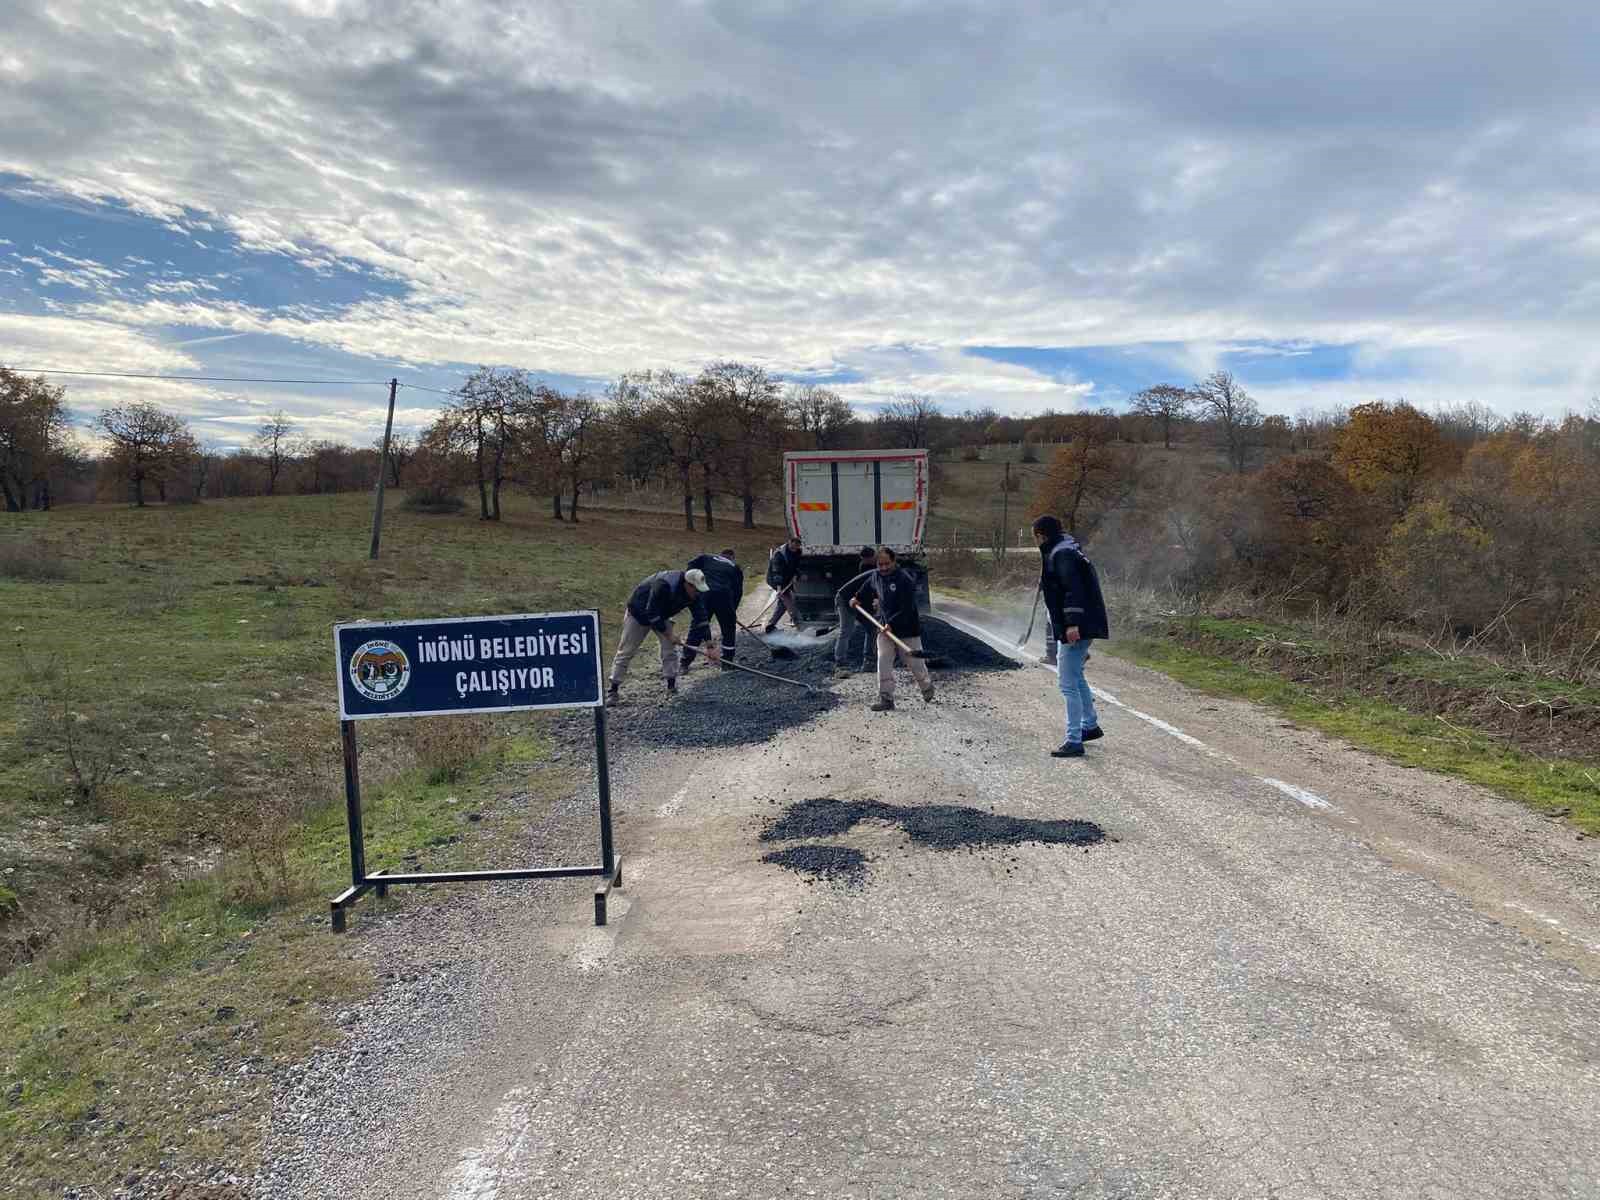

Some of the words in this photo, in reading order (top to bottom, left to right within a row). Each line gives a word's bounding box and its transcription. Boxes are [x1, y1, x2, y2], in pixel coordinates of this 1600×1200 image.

[418, 634, 474, 663] İNÖNÜ
[480, 627, 588, 660] BELEDİYESİ
[456, 667, 554, 698] ÇALIŞIYOR
